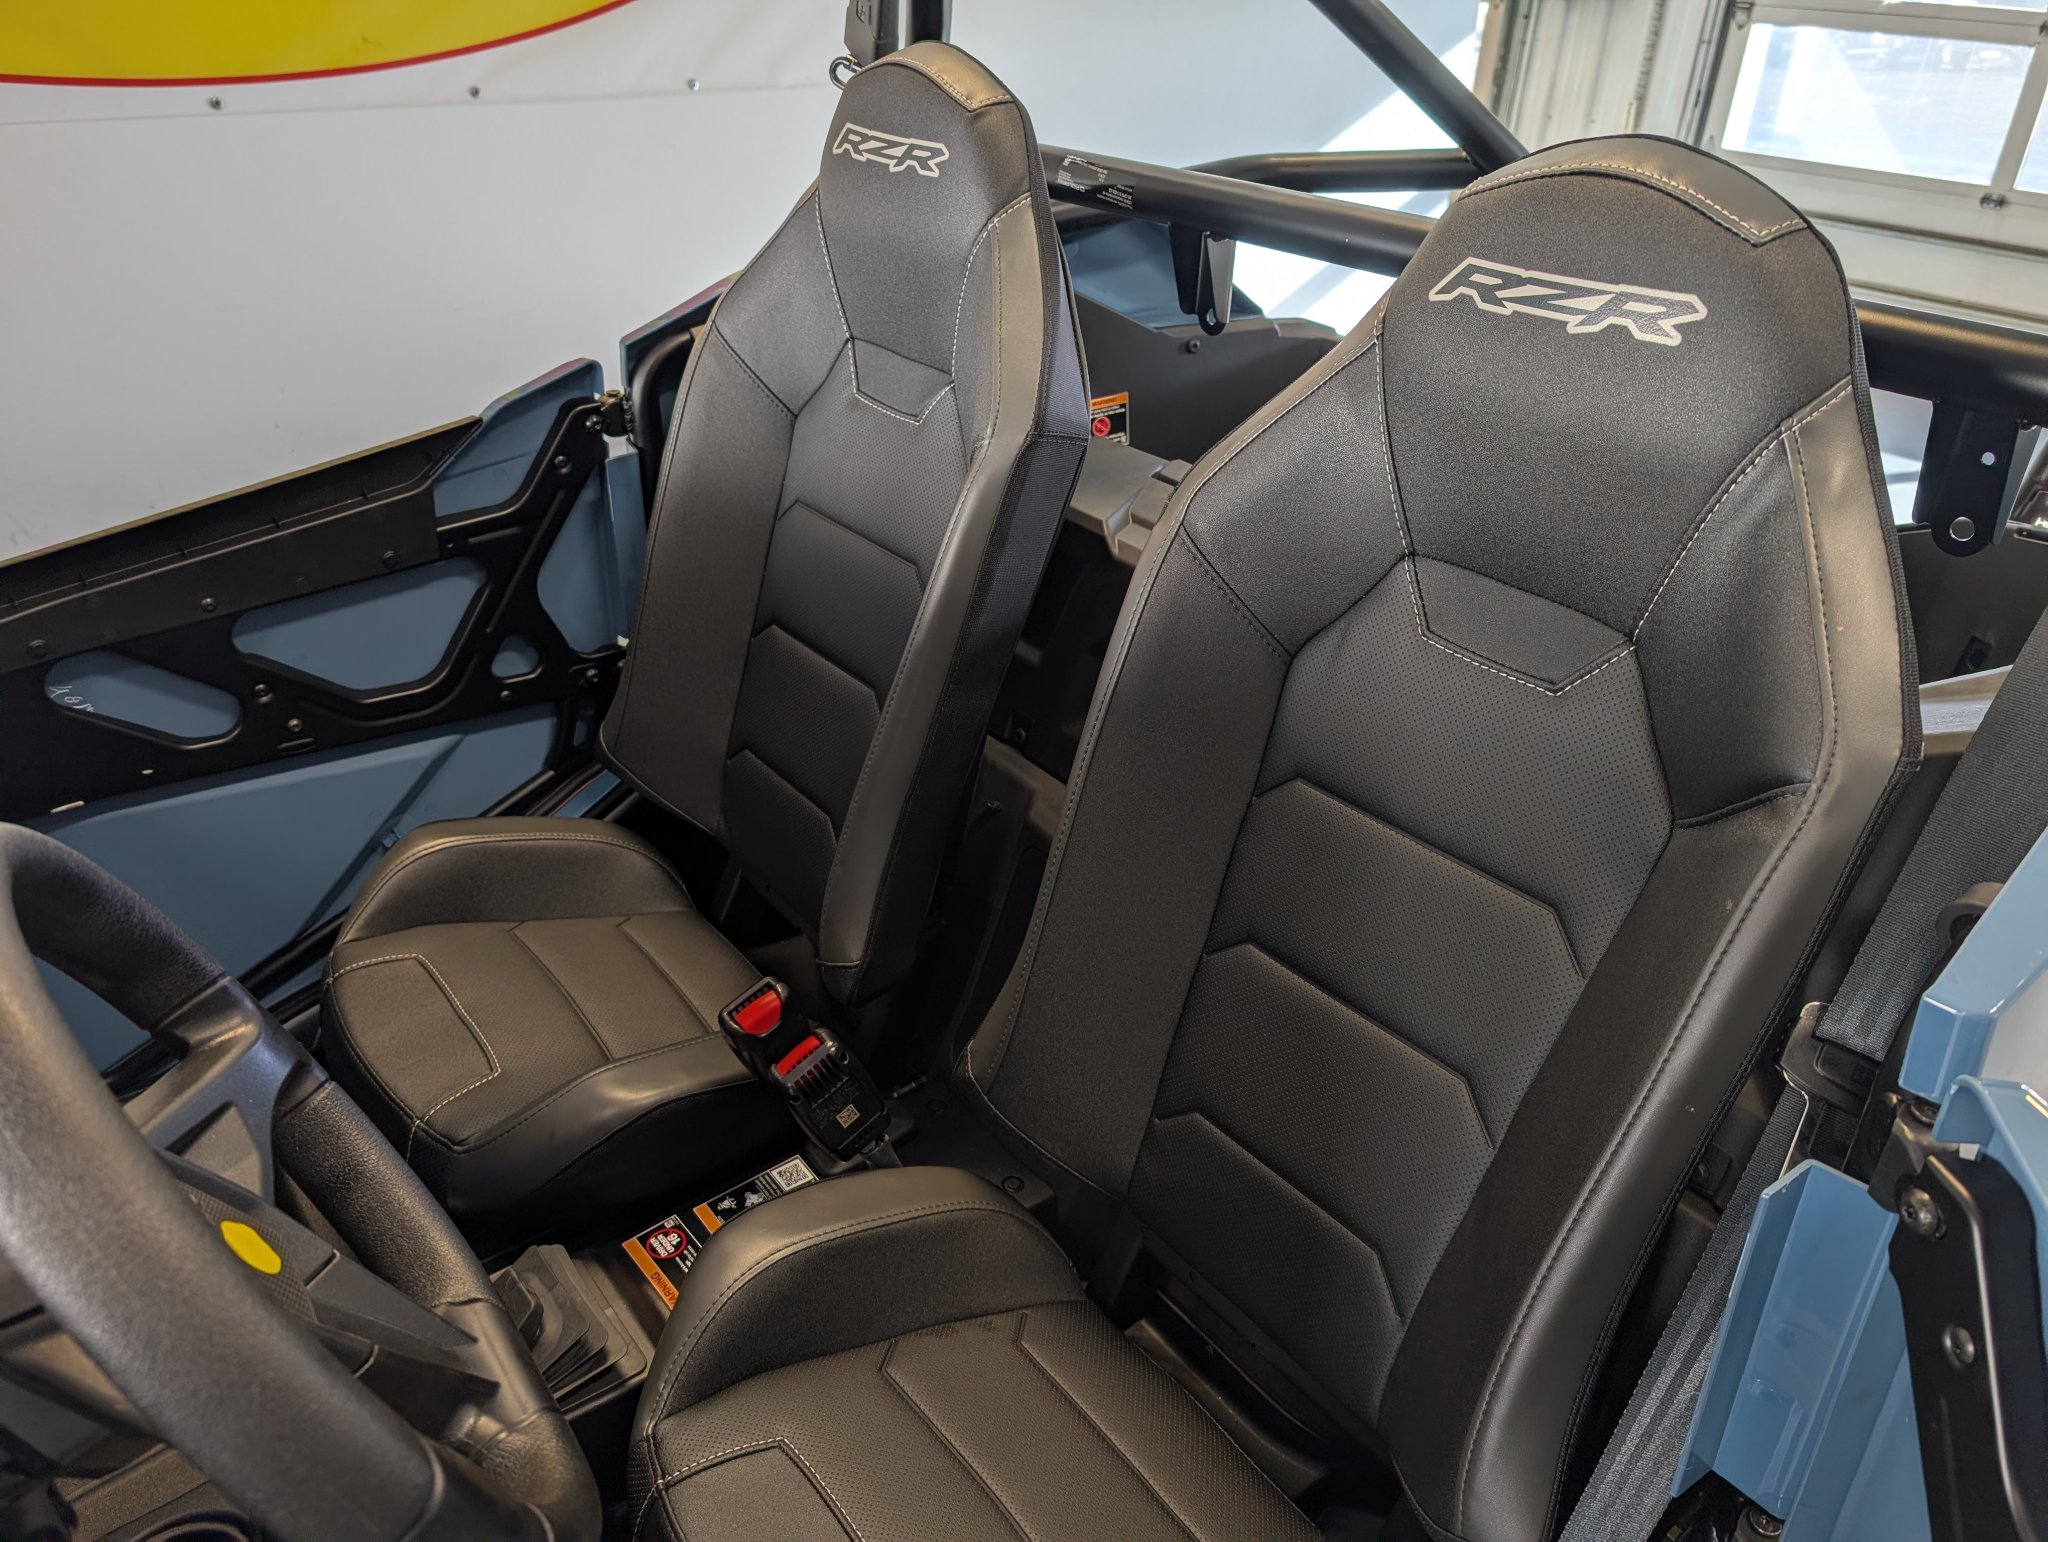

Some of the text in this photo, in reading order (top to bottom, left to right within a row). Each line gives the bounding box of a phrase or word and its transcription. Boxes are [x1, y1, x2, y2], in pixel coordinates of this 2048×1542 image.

[833, 122, 949, 177] RZR
[1429, 257, 1707, 346] RZR
[657, 1234, 675, 1253] UNDER
[667, 1233, 681, 1245] 16
[651, 1271, 676, 1305] ARNING
